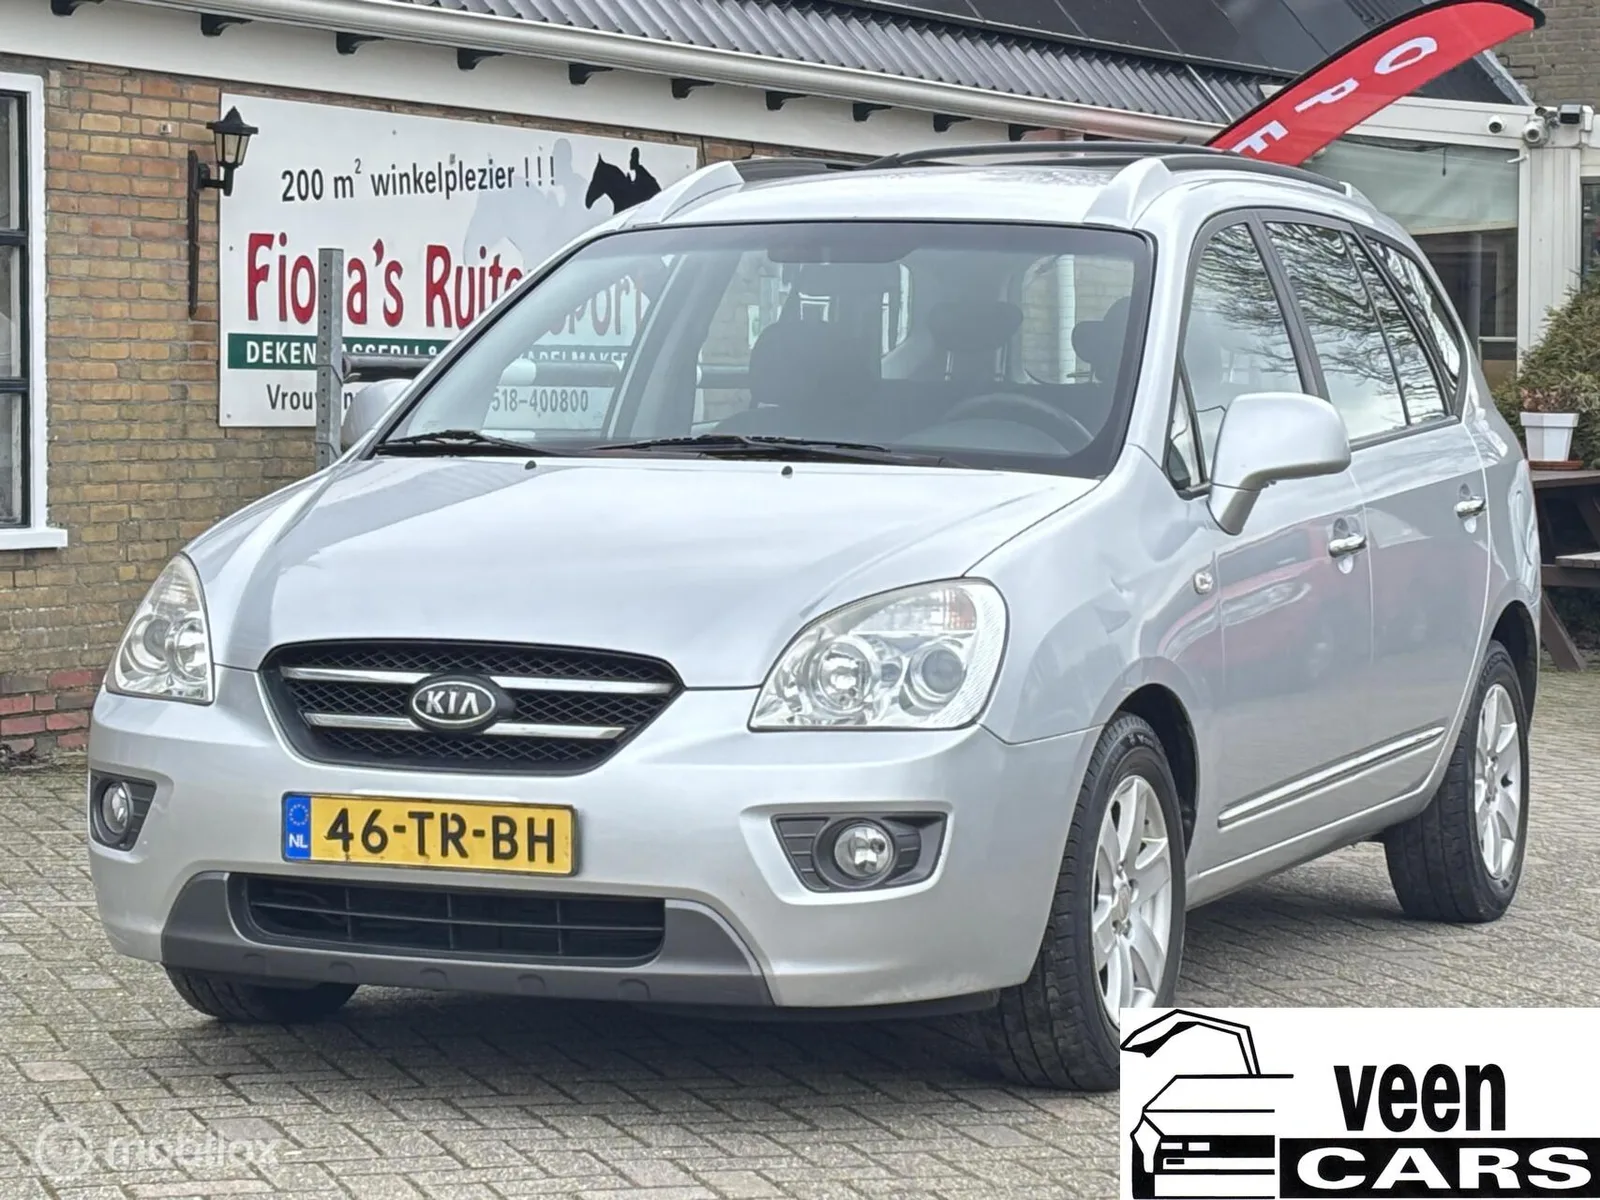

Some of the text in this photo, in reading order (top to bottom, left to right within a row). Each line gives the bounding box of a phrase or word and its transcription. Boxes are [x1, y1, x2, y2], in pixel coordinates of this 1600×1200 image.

[281, 168, 324, 202] 200
[370, 160, 515, 200] winkelplezier
[247, 231, 404, 328] Fioa's
[425, 689, 479, 716] KIA
[288, 807, 556, 864] NL 46-TR-BH
